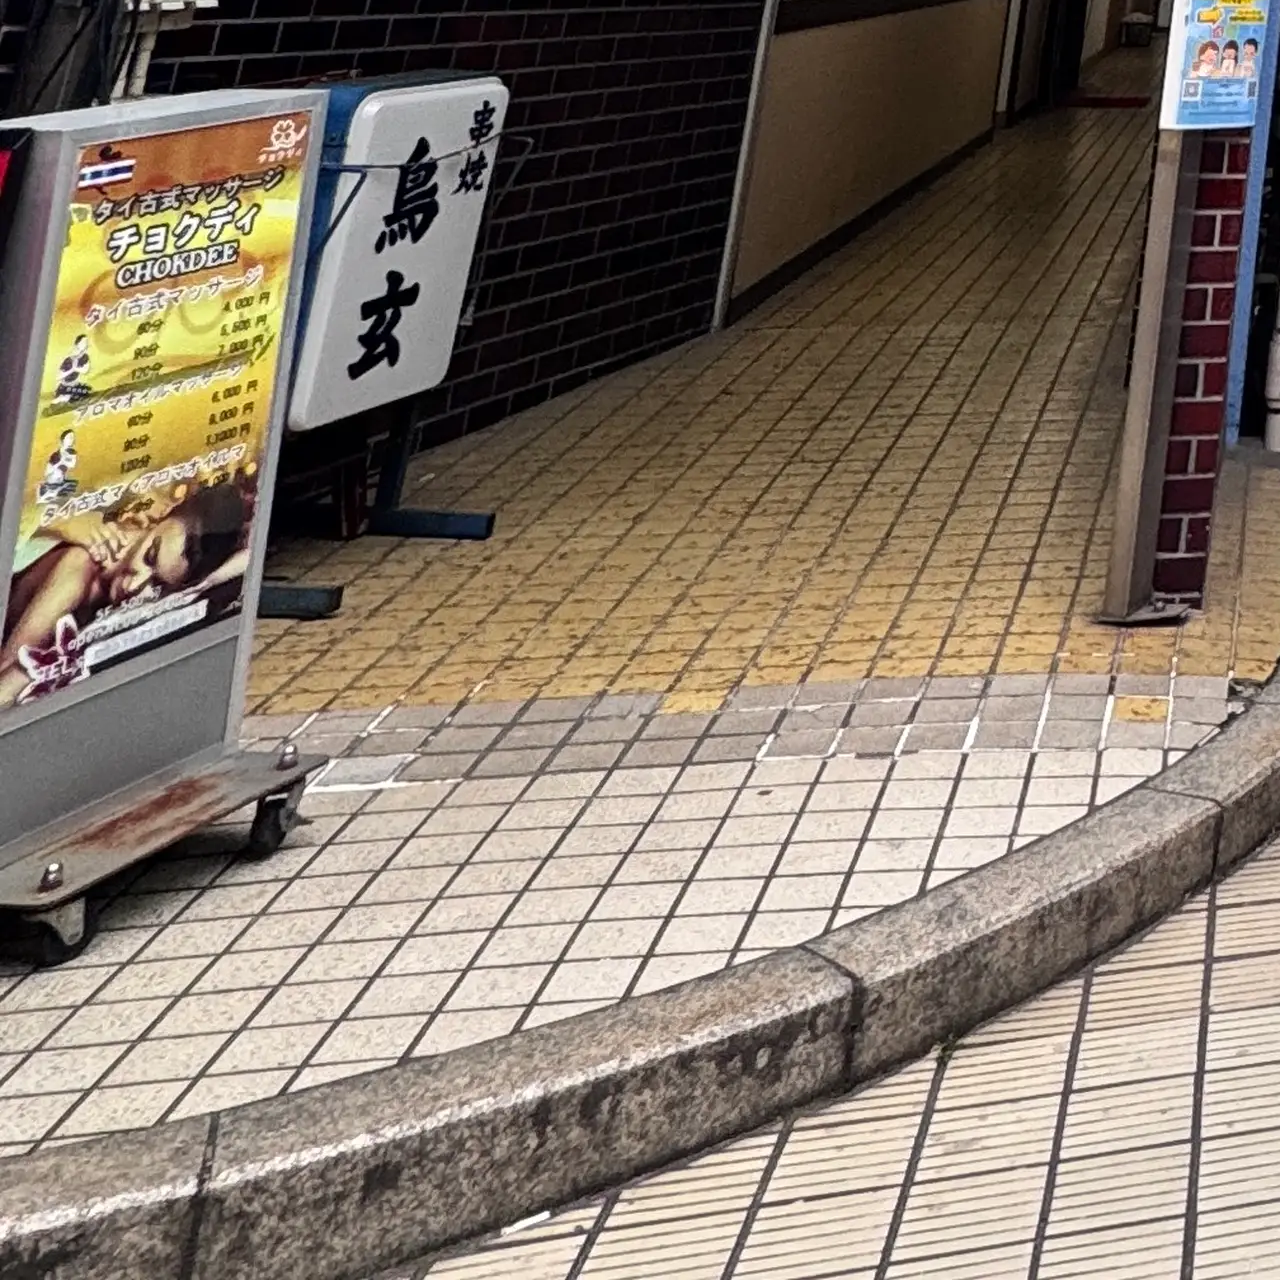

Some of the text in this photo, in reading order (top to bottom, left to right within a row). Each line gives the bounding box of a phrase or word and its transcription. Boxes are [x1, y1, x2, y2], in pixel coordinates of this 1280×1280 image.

[453, 100, 497, 195] 串焼
[95, 166, 286, 224] タイ古式マッサージ
[108, 201, 261, 263] チョクディ
[346, 135, 440, 381] 鳥玄
[115, 240, 240, 289] CHOKDEE
[85, 265, 264, 328] タイ古式マッサージ
